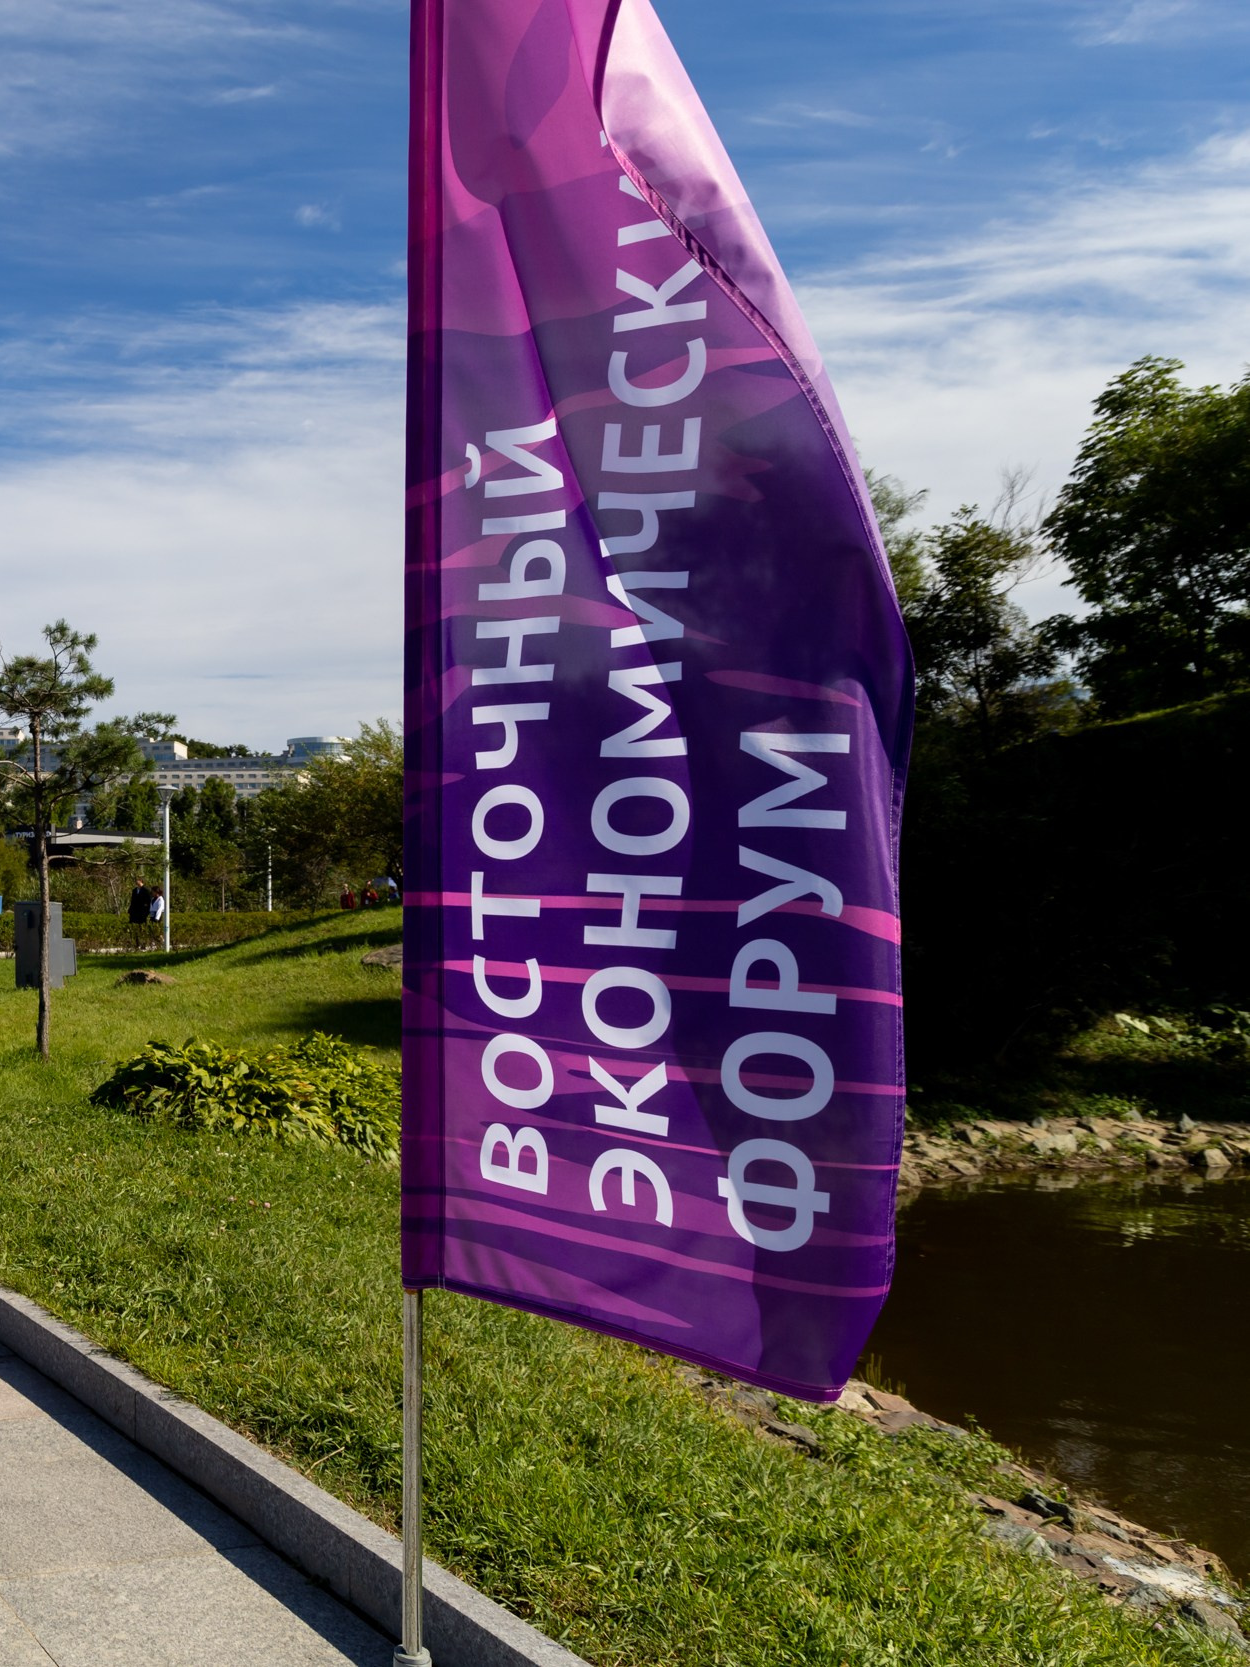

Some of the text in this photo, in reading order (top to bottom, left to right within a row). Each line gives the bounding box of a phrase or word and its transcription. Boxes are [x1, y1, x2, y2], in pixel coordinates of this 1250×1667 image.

[464, 417, 567, 1196] ВОСТОЧНЫЙ
[581, 130, 707, 1228] ЭКОНОМИЧЕСК
[716, 731, 851, 1252] ФОРУМ
